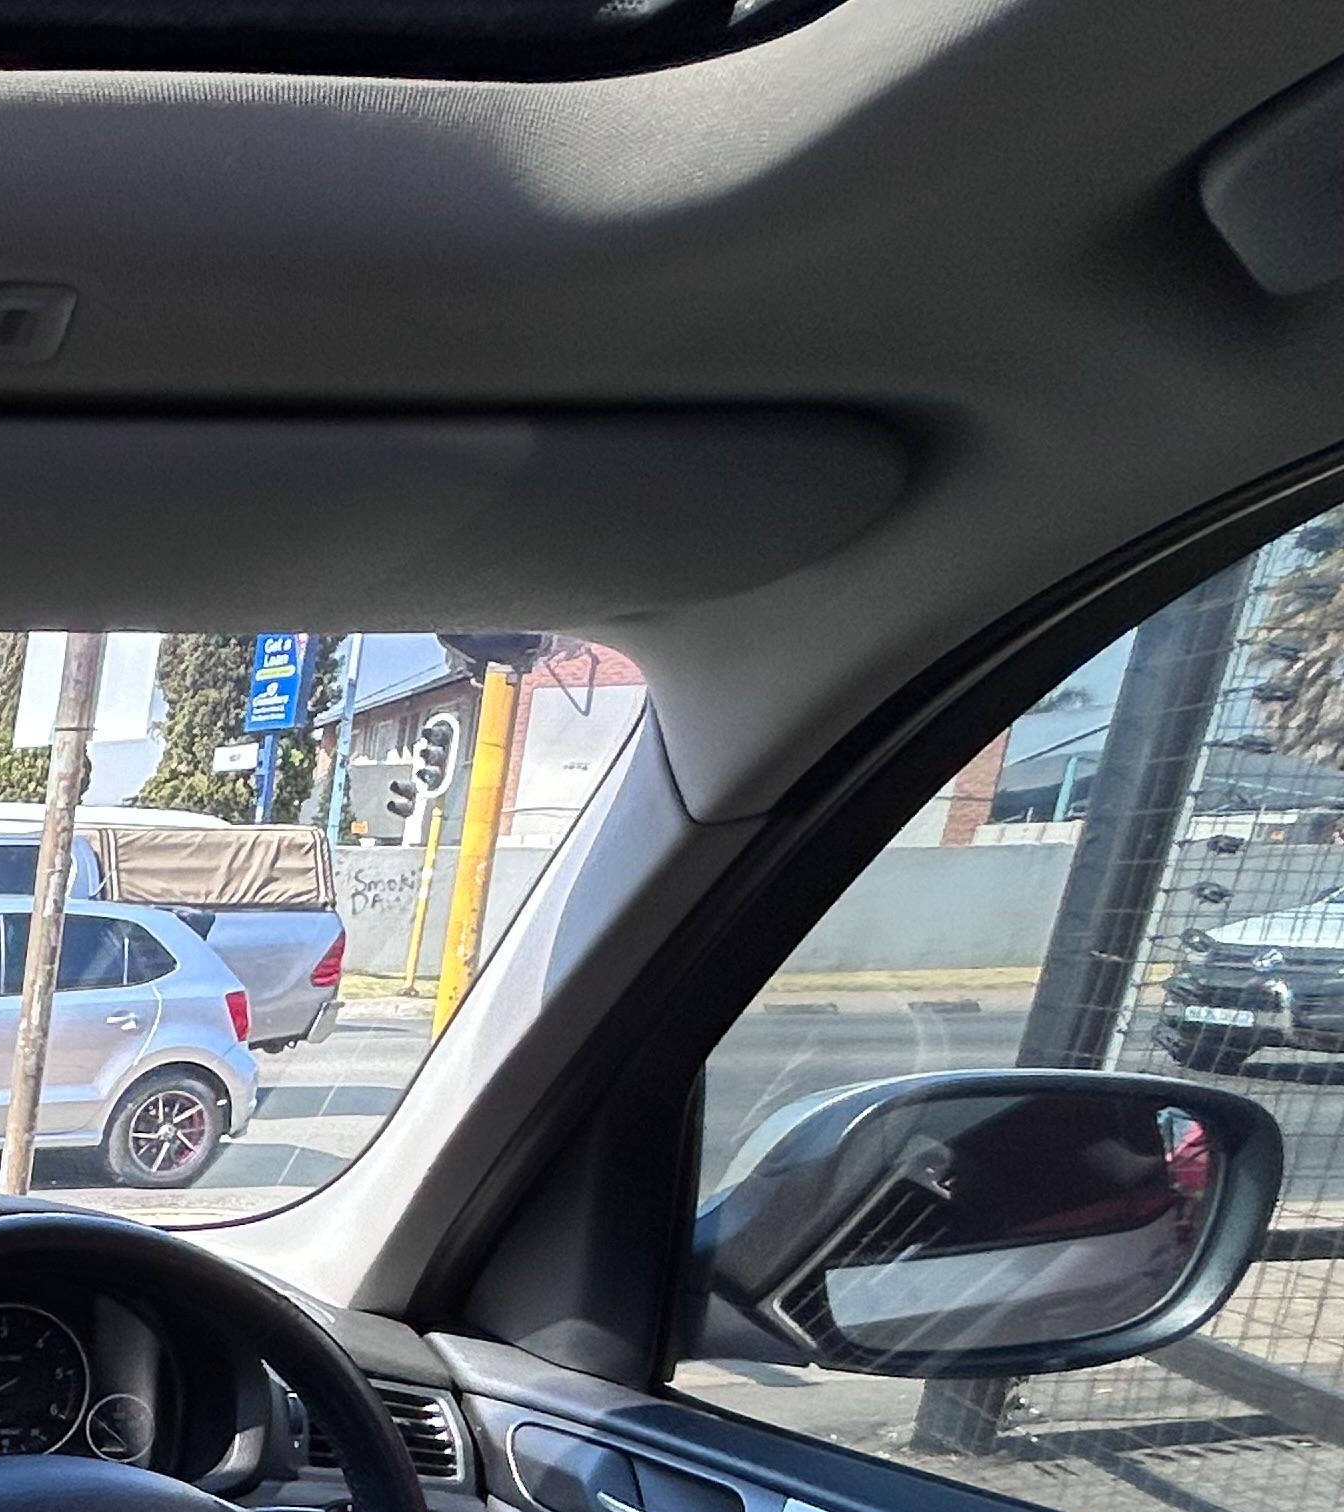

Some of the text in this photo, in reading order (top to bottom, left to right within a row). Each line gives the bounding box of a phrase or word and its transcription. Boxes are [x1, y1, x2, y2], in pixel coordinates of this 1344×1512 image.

[264, 637, 283, 654] Get
[263, 653, 290, 668] Loan
[50, 1403, 58, 1416] 6
